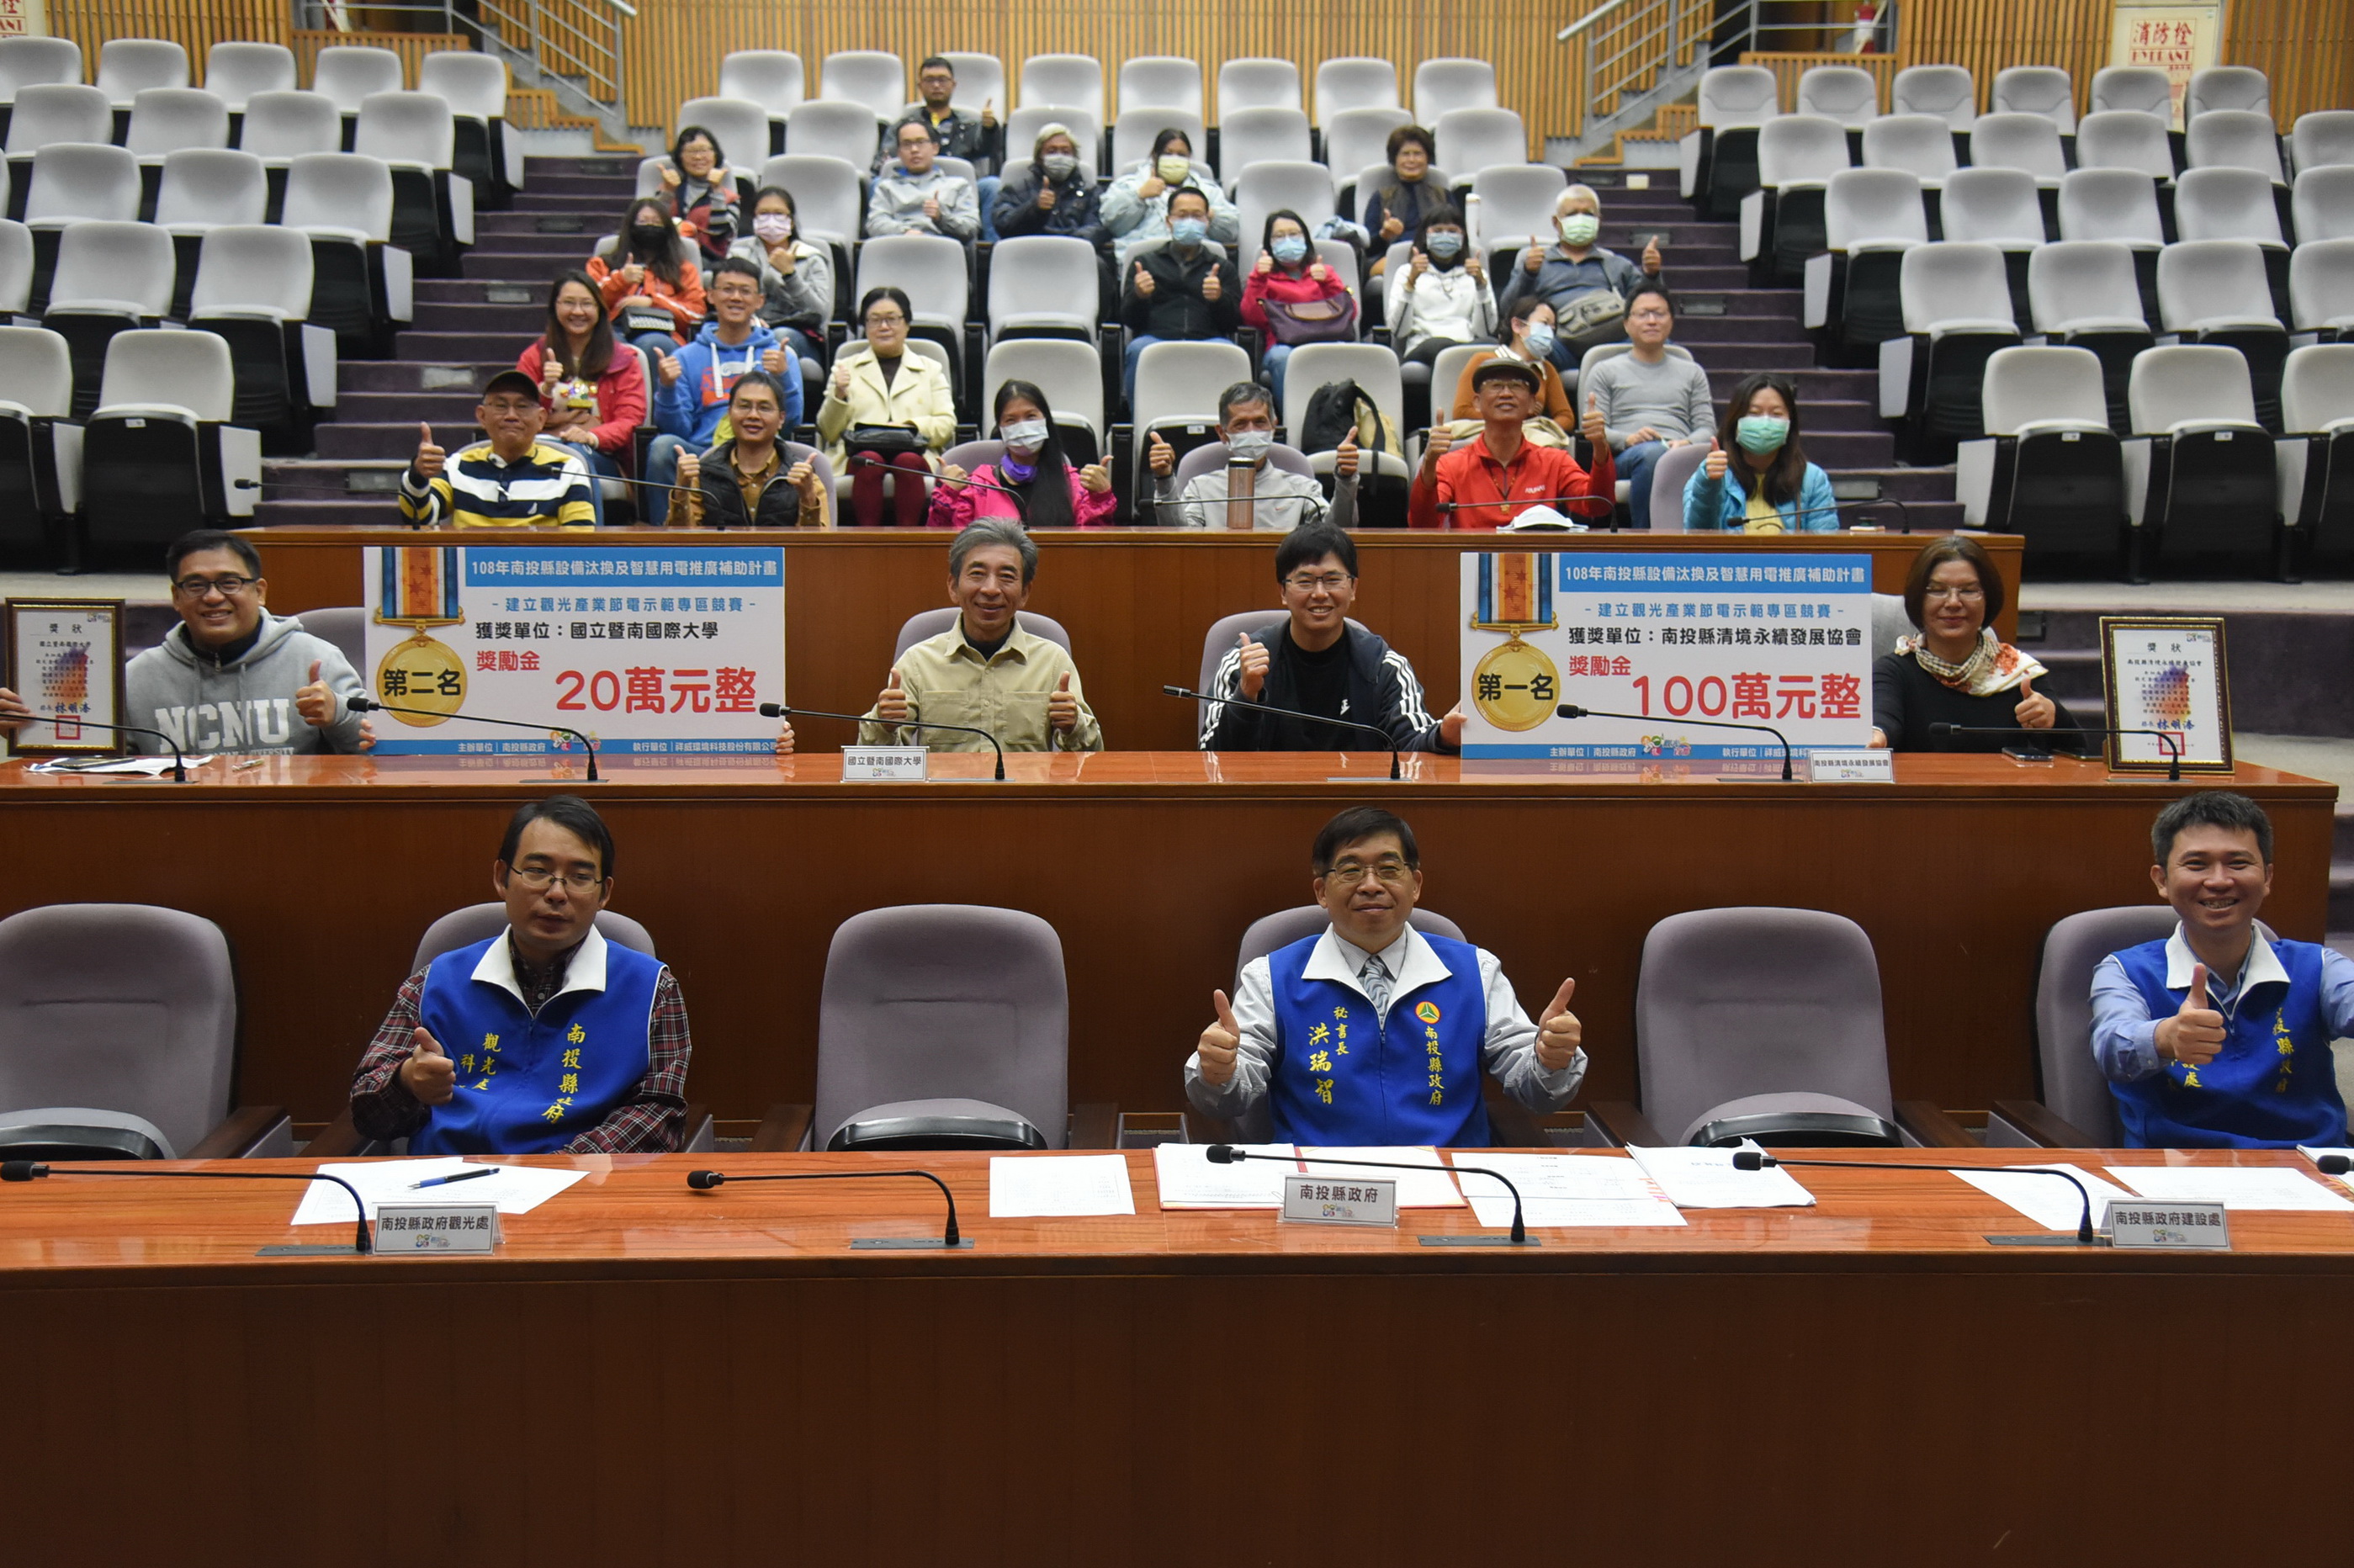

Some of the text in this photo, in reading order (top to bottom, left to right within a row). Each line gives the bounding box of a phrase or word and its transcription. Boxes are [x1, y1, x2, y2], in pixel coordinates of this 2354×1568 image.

[472, 560, 777, 576] 108年南投縣設備汰換及智慧用電推廣補助計畫
[1566, 565, 1864, 583] 108年南投縣設備汰換及智慧用電推廣補助計畫
[477, 650, 540, 671] 獎勵金
[1569, 655, 1631, 676] 獎勵金
[383, 668, 462, 697] 第二名
[555, 665, 756, 714] 20萬元整
[1477, 673, 1555, 702] 第一名
[1632, 672, 1861, 720] 100萬元整
[155, 698, 290, 754] NCNU
[847, 756, 922, 766] 國立暨南國際大學
[1333, 1006, 1349, 1056] 秘書長
[1308, 1022, 1335, 1104] 洪瑞智
[1424, 1025, 1445, 1105] 南投縣政府
[1300, 1184, 1379, 1203] 南投縣政府
[381, 1216, 490, 1231] 南投縣政府觀光處
[2115, 1211, 2221, 1226] 南投縣政府建設處
